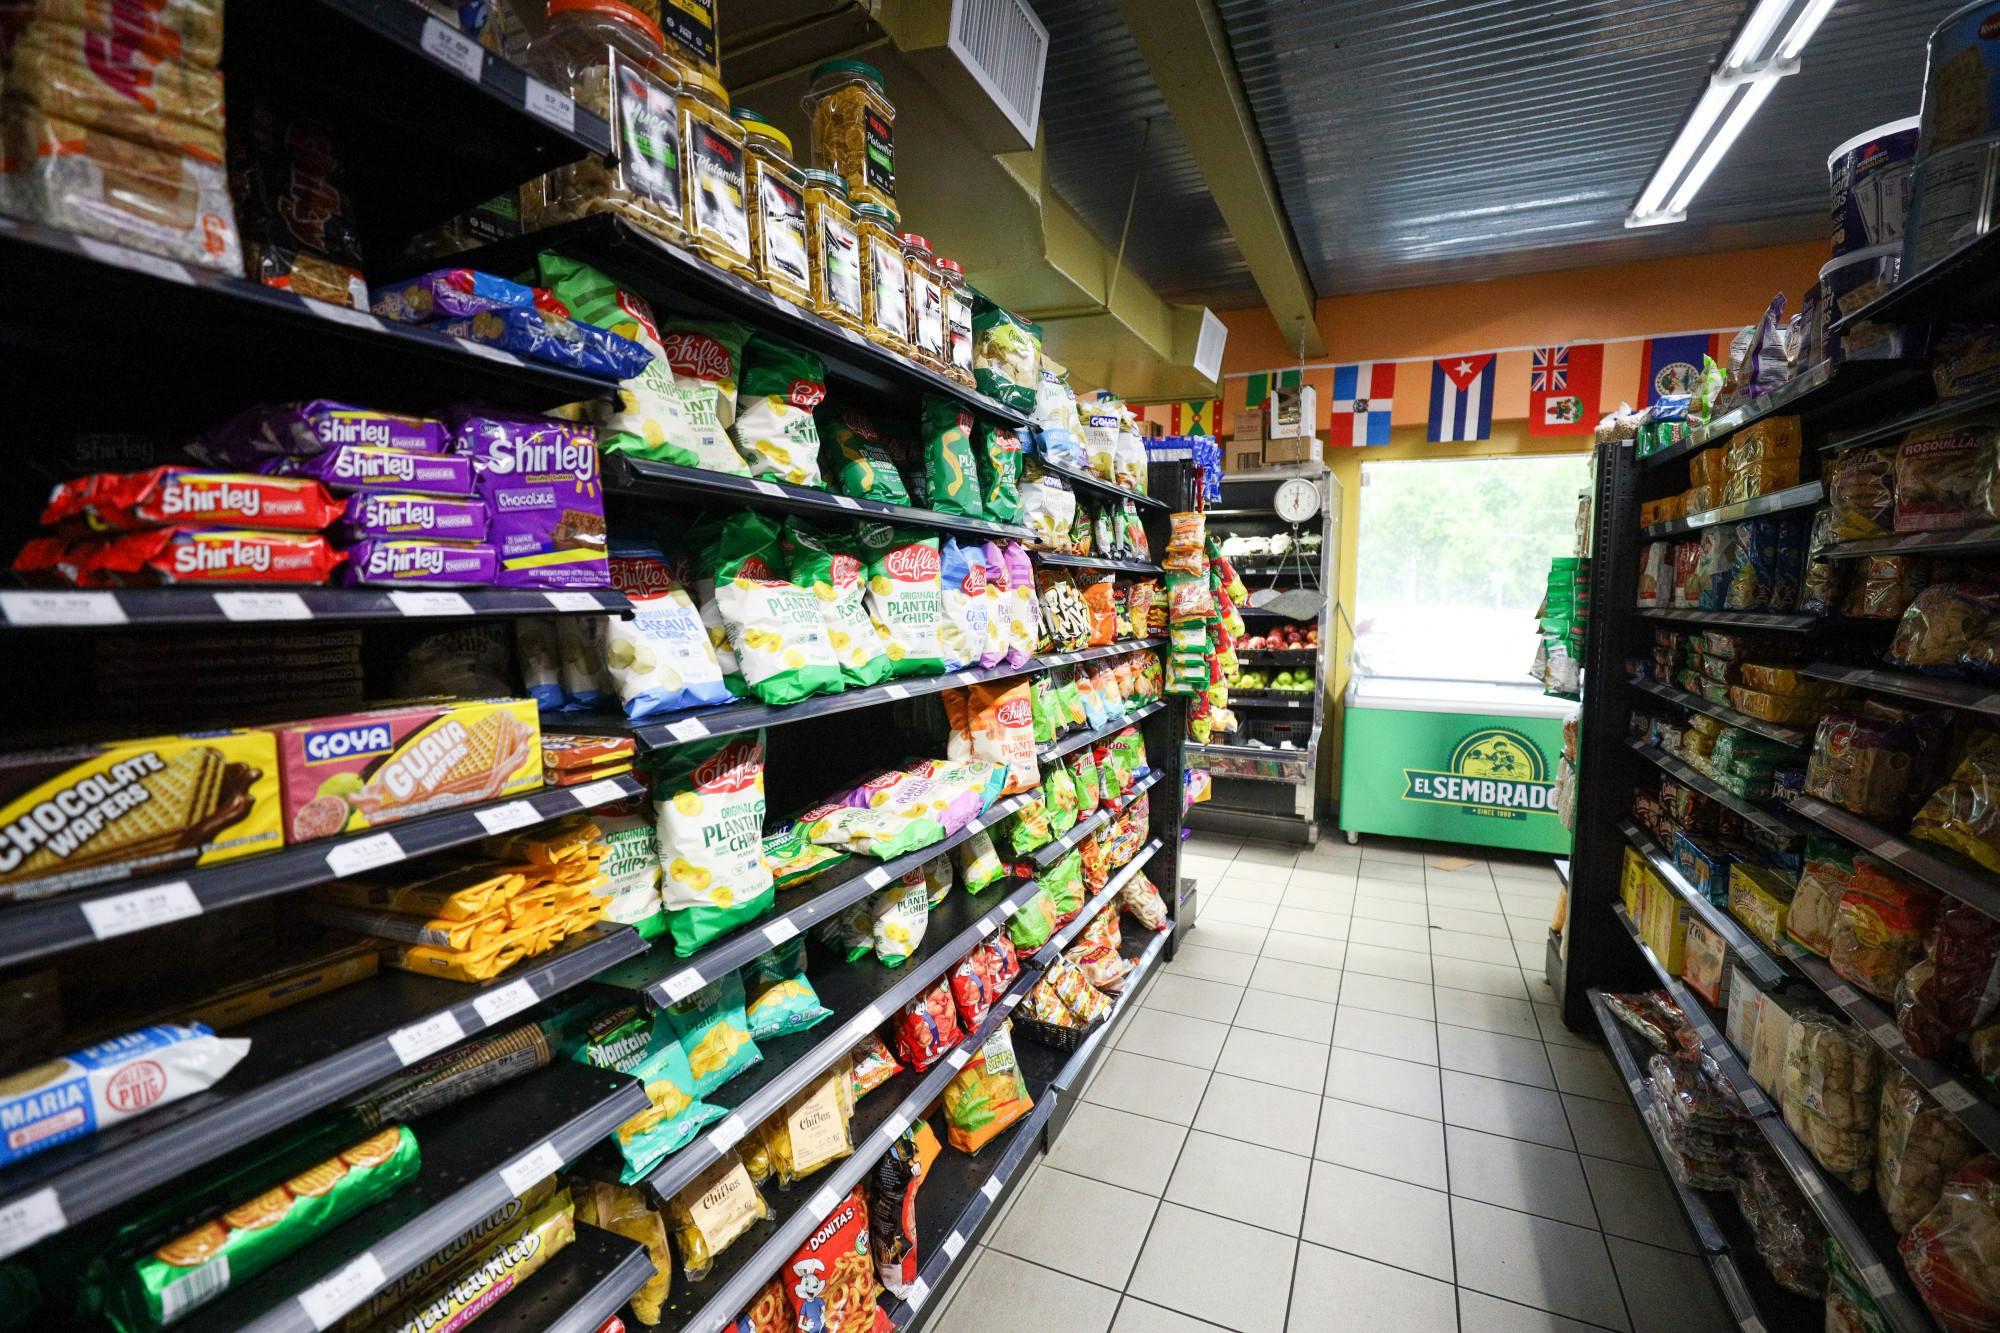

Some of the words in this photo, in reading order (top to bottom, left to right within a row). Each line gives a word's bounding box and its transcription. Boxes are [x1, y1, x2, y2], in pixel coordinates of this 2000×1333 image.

[665, 334, 730, 377] Chifles
[318, 420, 390, 448] Shirley
[1090, 417, 1118, 427] GOYA
[391, 438, 427, 449] Chocolate
[1905, 438, 1979, 456] ROSQUILLAS
[336, 455, 415, 481] Shirley
[487, 435, 594, 482] Shirley
[416, 469, 455, 480] Chocolate
[162, 484, 260, 516] Shirley
[263, 501, 305, 515] Original
[499, 491, 555, 508] Chocolate
[366, 502, 435, 530] Shirley
[436, 516, 473, 528] Chocolate
[871, 533, 890, 547] SIZE
[175, 544, 270, 572] Shirley
[273, 555, 314, 570] Original
[368, 547, 445, 575] Shirley
[445, 559, 481, 571] Chocolate
[888, 550, 940, 581] Chifles
[609, 561, 669, 598] Chifles
[633, 616, 699, 633] CASSAVA
[902, 612, 934, 624] CHIPS
[308, 728, 390, 760] GOYA
[385, 720, 468, 798] GUAVA
[421, 745, 468, 791] WAFERS
[1415, 777, 1432, 794] EL
[1433, 776, 1559, 811] SEMBRADO
[0, 752, 165, 872] CHOCOLATE
[48, 783, 151, 859] WAFERS
[610, 857, 648, 878] CHIPS
[589, 1031, 652, 1069] Plantain
[614, 1050, 649, 1075] Chips
[1, 1082, 86, 1130] MARIA
[119, 1077, 160, 1107] PUIG
[799, 1109, 831, 1131] Chifles
[703, 1179, 741, 1211] Chifles
[810, 1208, 854, 1251] DONITAS
